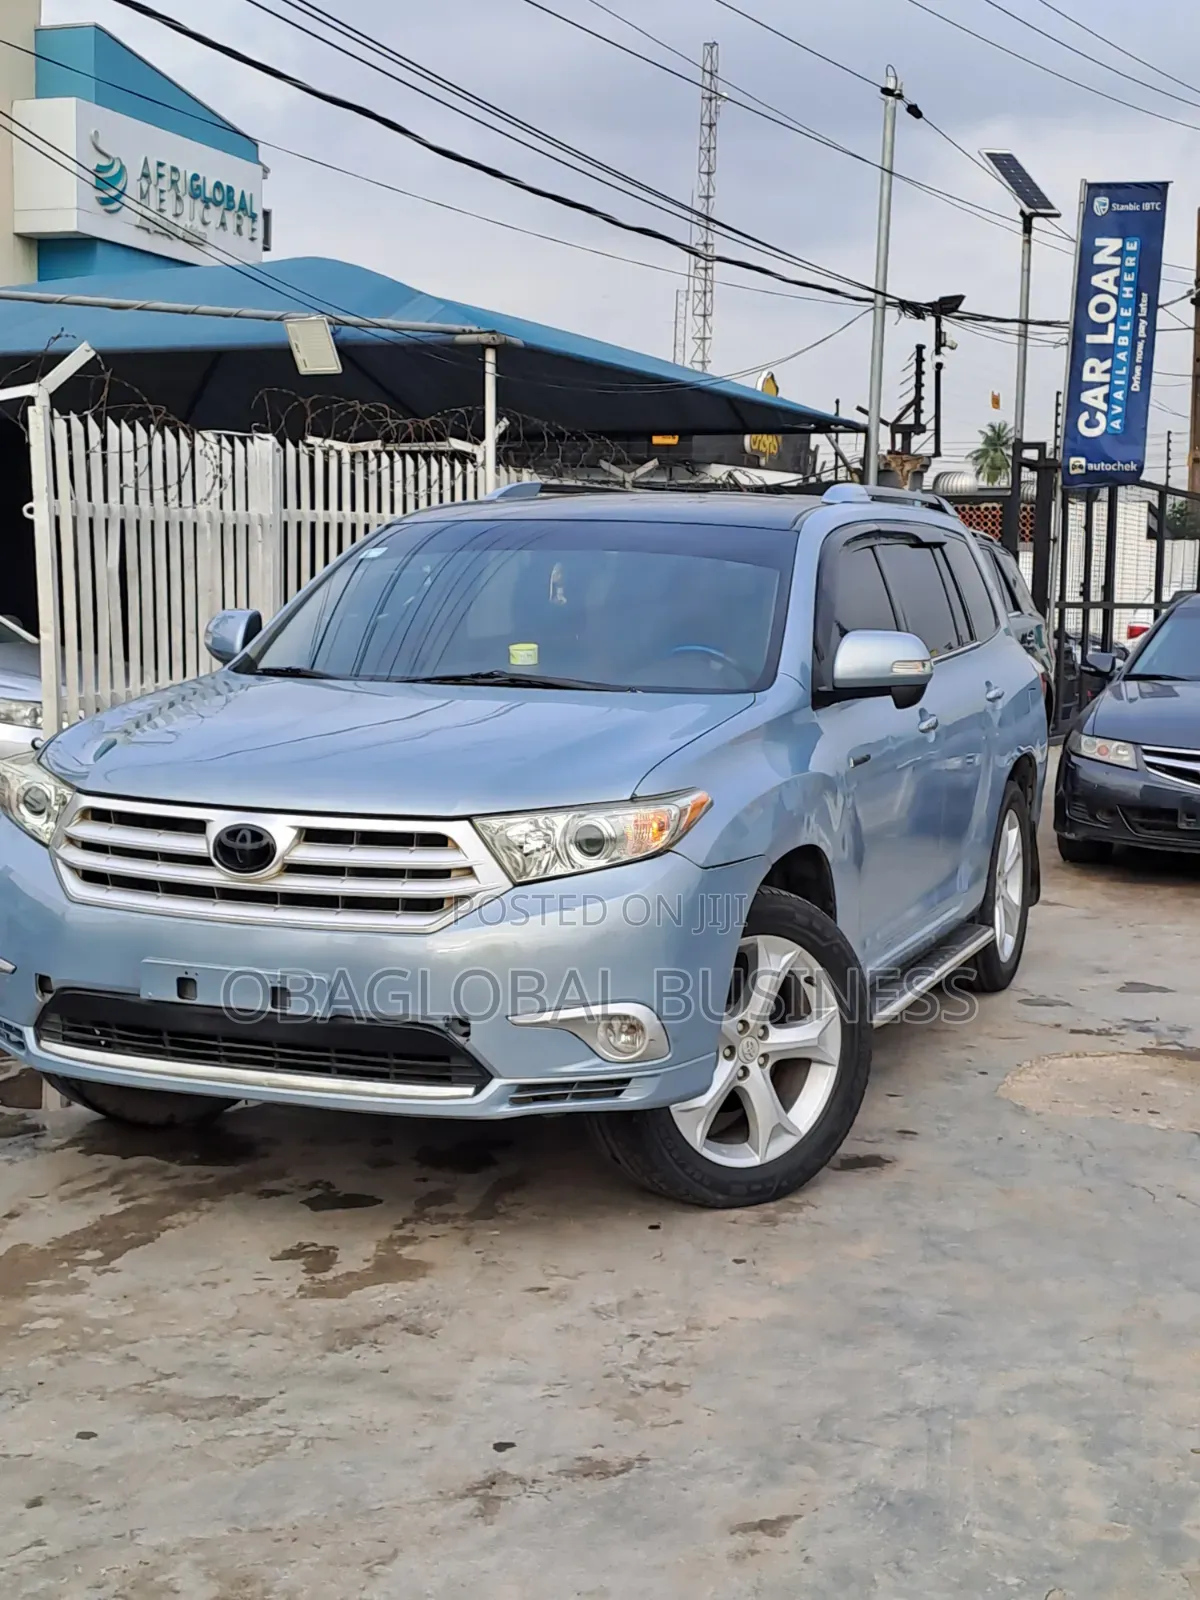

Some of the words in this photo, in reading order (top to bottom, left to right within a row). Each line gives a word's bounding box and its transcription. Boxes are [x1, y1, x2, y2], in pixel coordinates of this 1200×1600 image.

[137, 155, 258, 220] AFRIGLOBAL
[138, 180, 258, 242] MEDICARE
[1111, 202, 1140, 211] Stanbic
[1142, 202, 1161, 211] IBTC
[1085, 237, 1123, 344] LOAN
[1110, 307, 1132, 430] AVAILABLE
[1122, 240, 1138, 298] HERE
[1131, 365, 1142, 391] Drive
[1138, 292, 1148, 316] later
[1077, 357, 1112, 438] CAR
[1087, 460, 1138, 471] autochek
